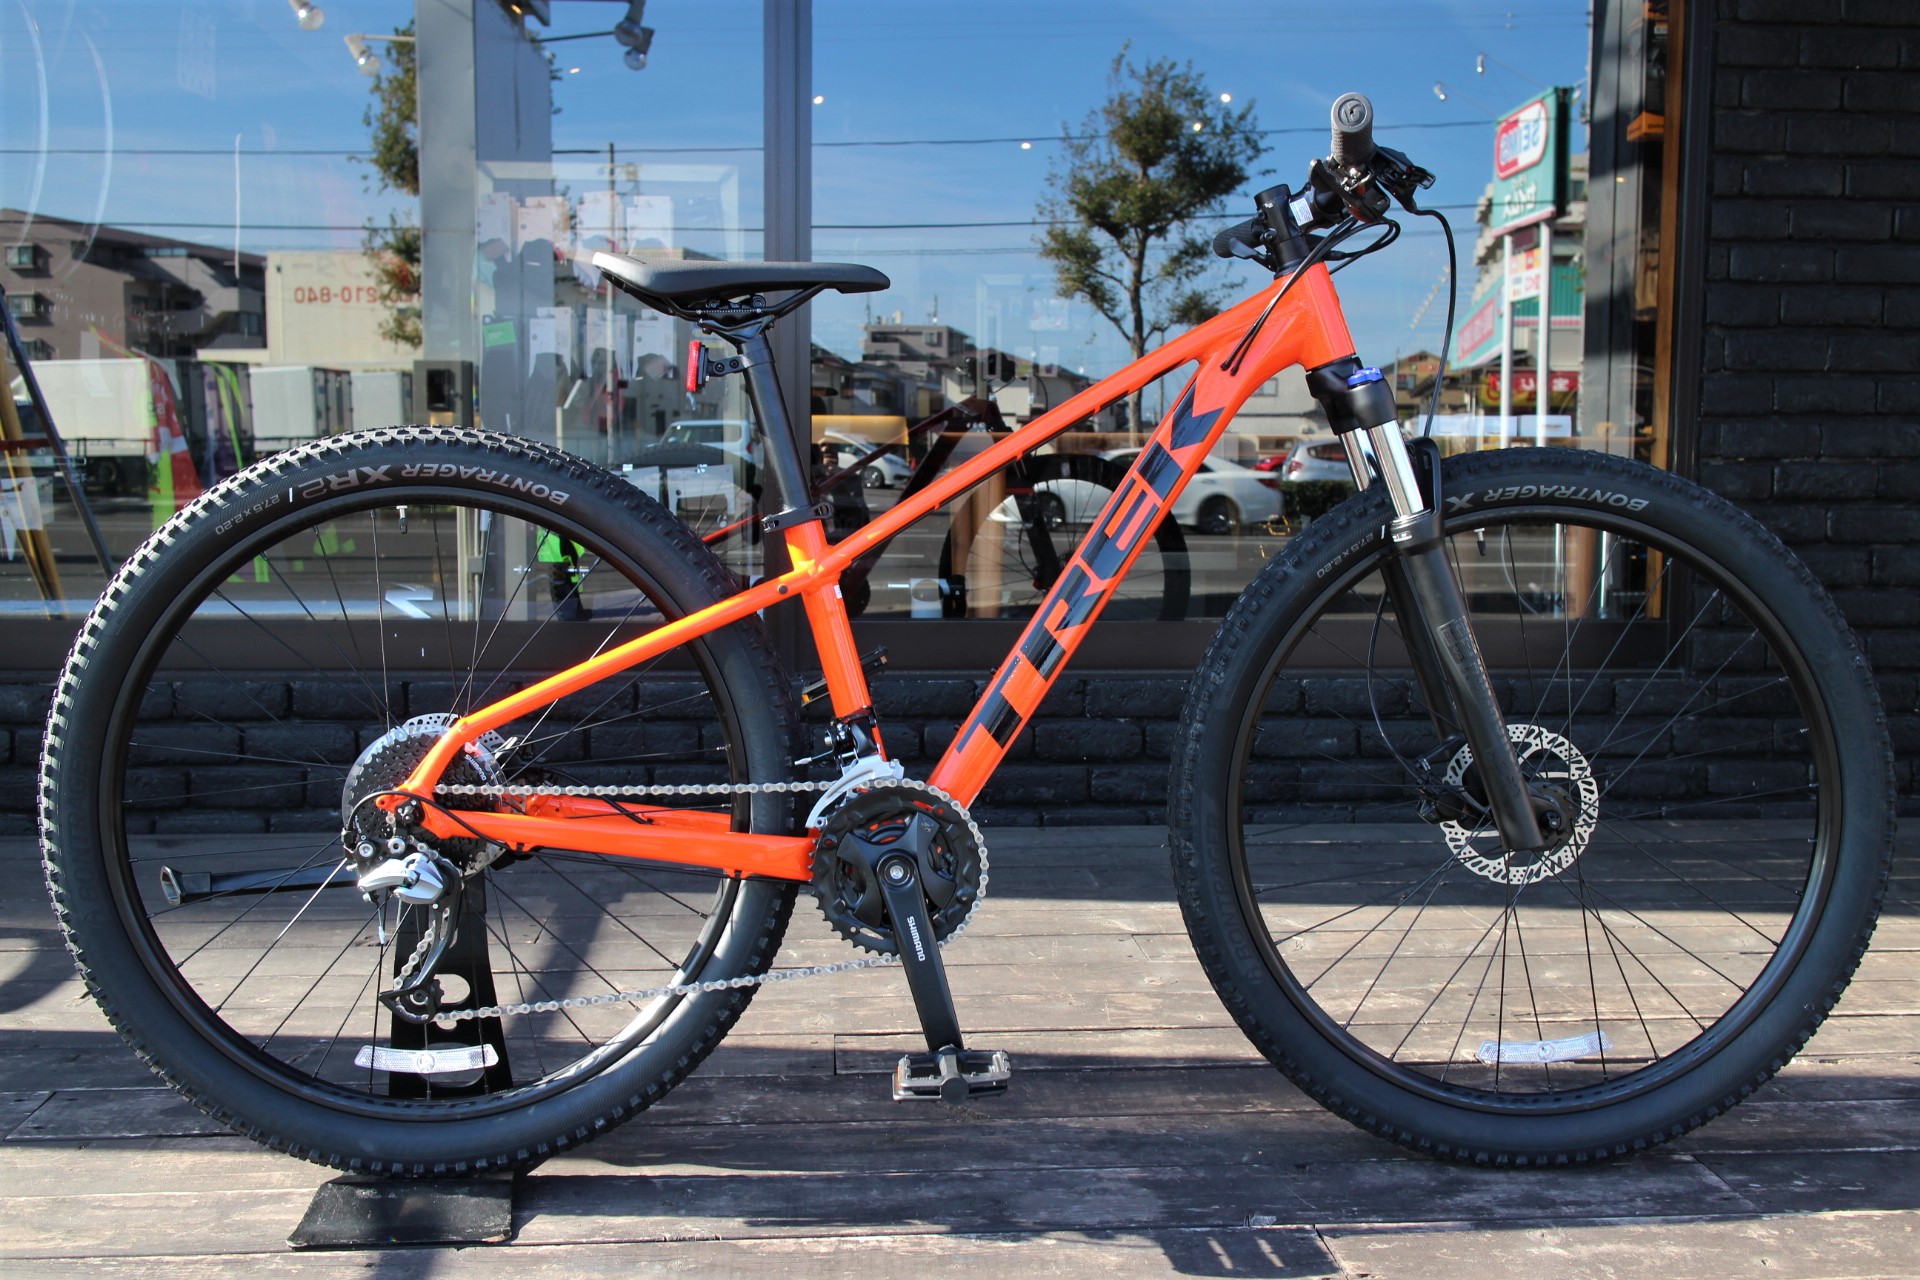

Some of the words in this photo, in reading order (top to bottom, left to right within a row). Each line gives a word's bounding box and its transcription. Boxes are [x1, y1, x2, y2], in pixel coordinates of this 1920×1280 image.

[298, 464, 393, 500] XR2
[401, 463, 570, 506] BONTRAGER
[1483, 484, 1650, 512] BONTRAGER
[955, 376, 1226, 753] TREK
[465, 753, 488, 782] SHIMANO
[907, 915, 926, 962] SHIMANO
